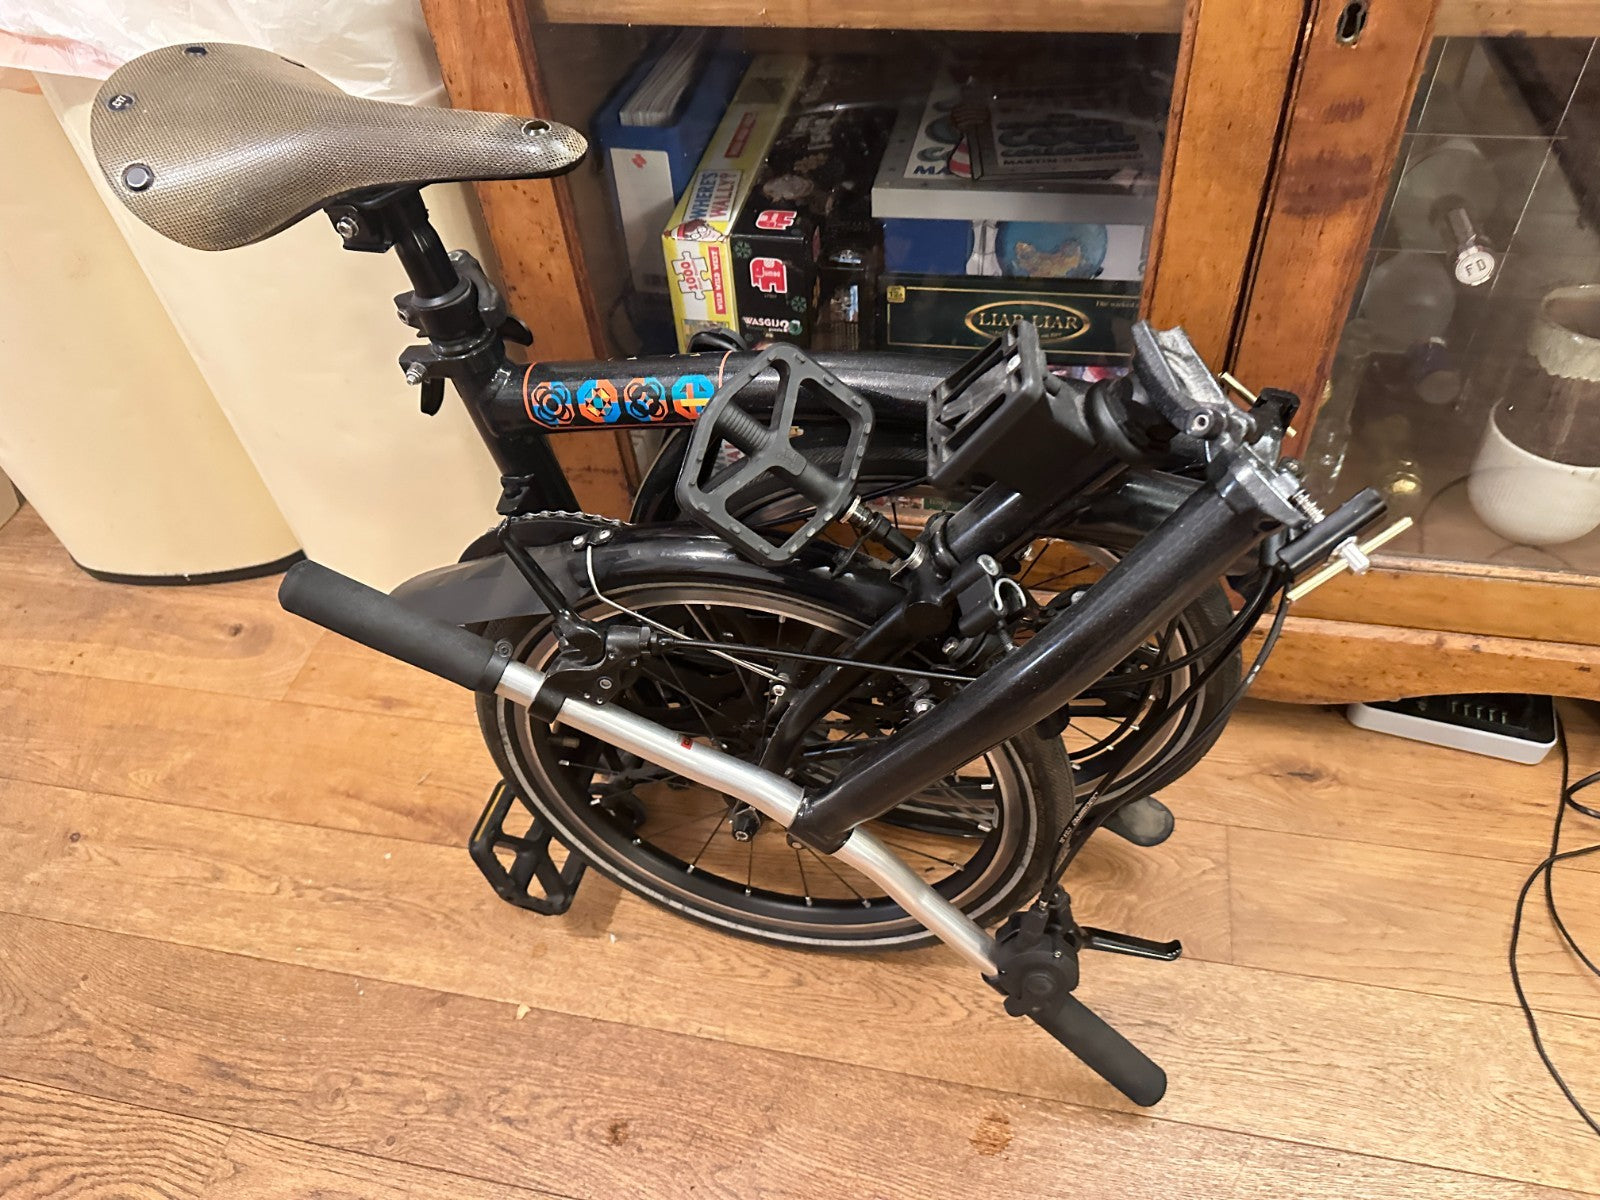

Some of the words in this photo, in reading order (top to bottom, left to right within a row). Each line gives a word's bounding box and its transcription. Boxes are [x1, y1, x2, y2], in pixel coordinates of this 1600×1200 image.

[688, 172, 718, 219] WHERE'S
[709, 172, 736, 218] WALLY?
[711, 249, 720, 270] WEST
[680, 261, 699, 291] 1000
[713, 272, 722, 290] WILD
[715, 293, 724, 311] WILD
[1032, 314, 1079, 330] LIAR
